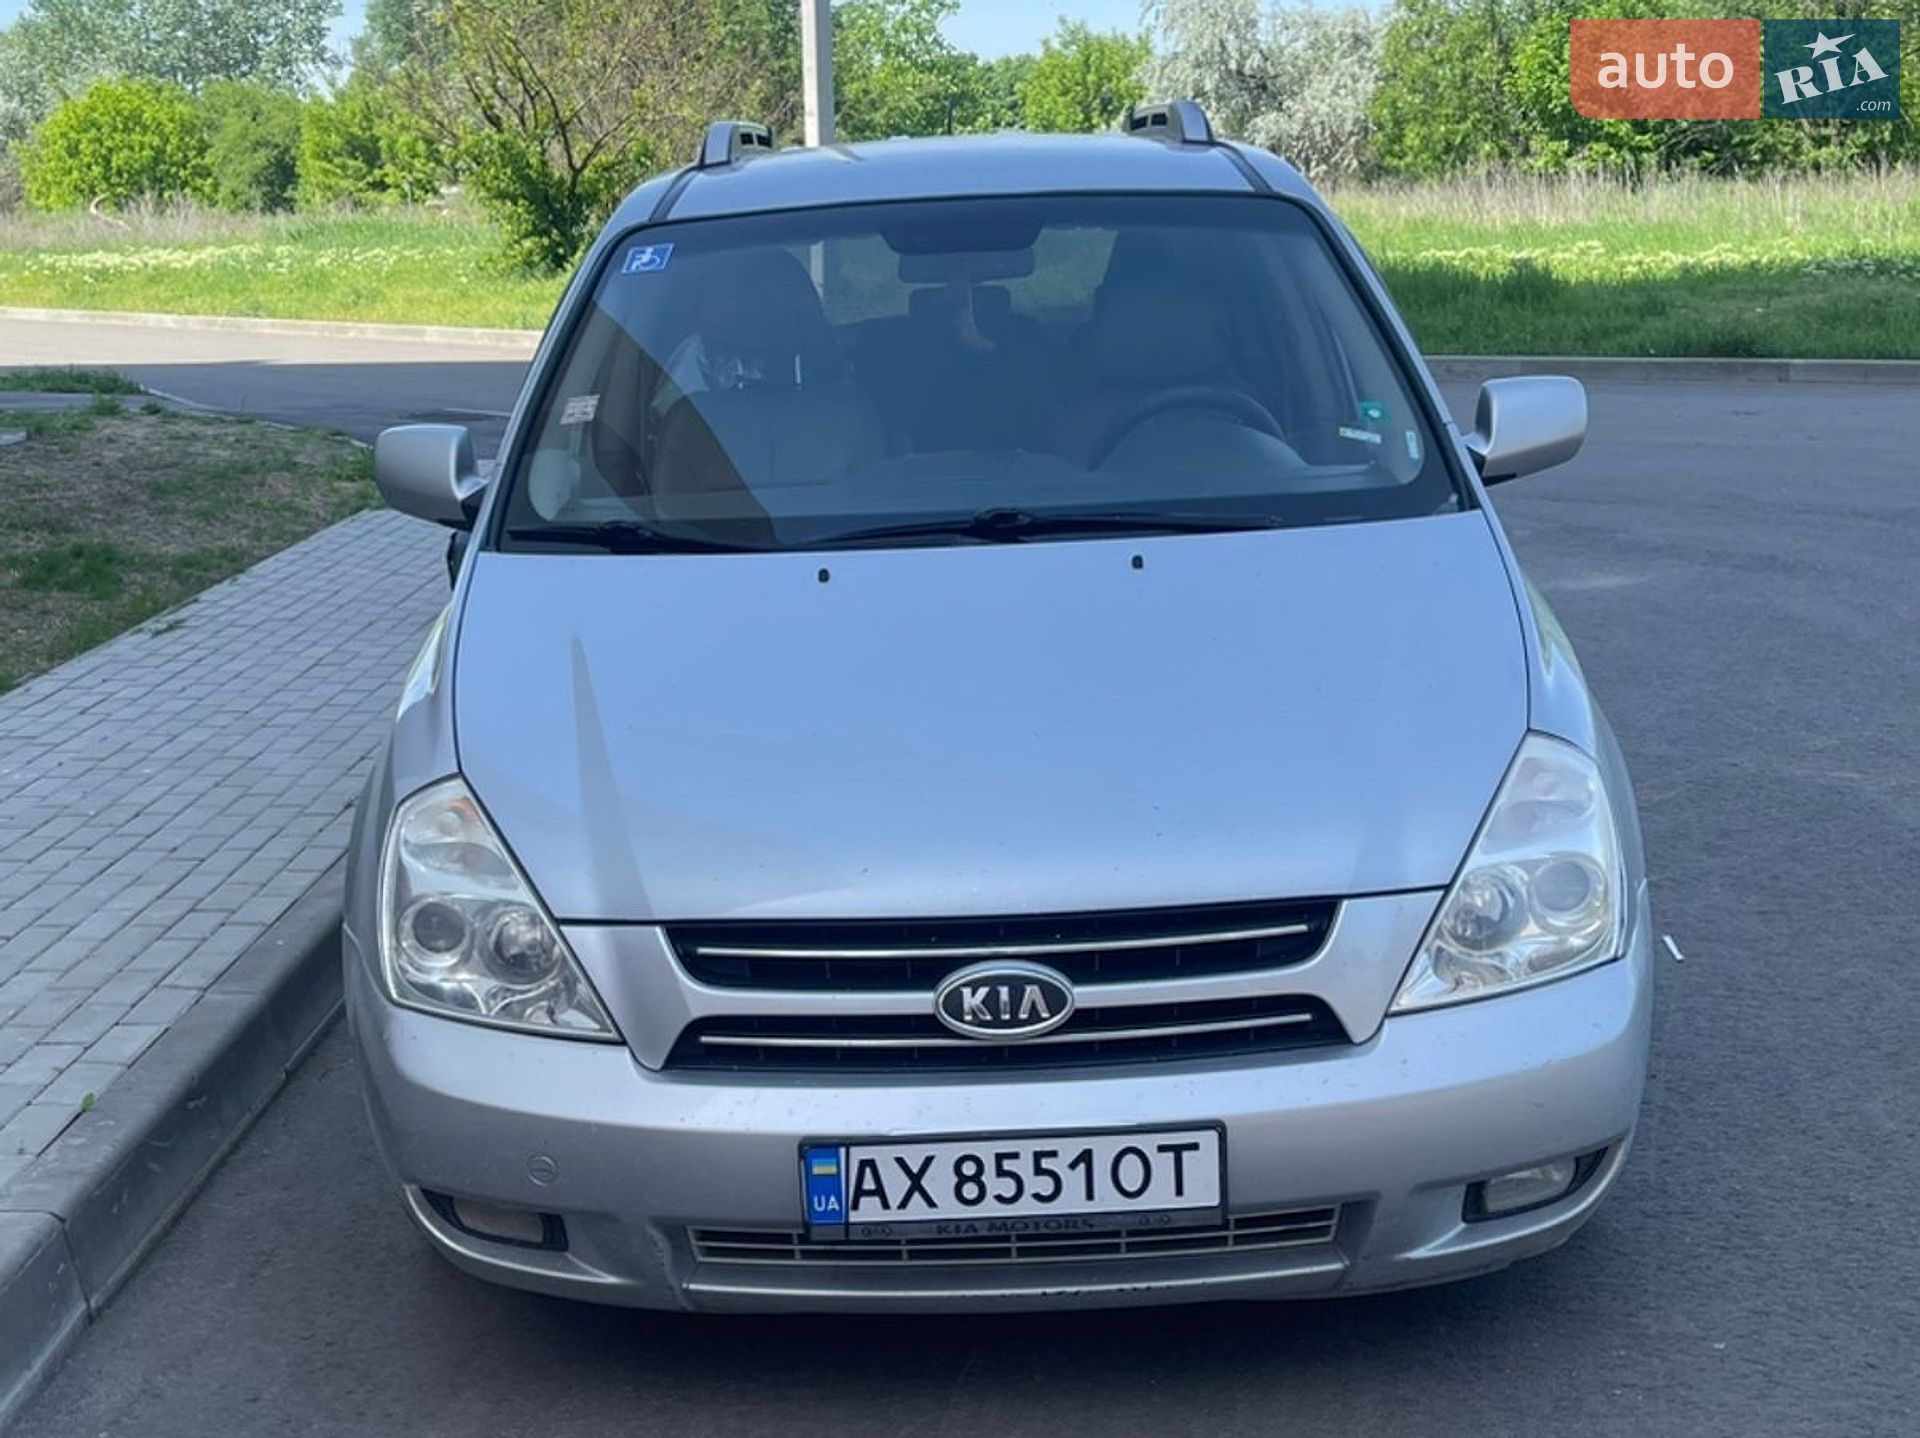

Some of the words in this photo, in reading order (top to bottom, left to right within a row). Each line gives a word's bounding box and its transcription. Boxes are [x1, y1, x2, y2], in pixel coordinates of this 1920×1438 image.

[959, 983, 1051, 1021] KIA
[813, 1194, 840, 1212] UA
[936, 1223, 979, 1236] KIA
[987, 1218, 1095, 1233] MOTORS
